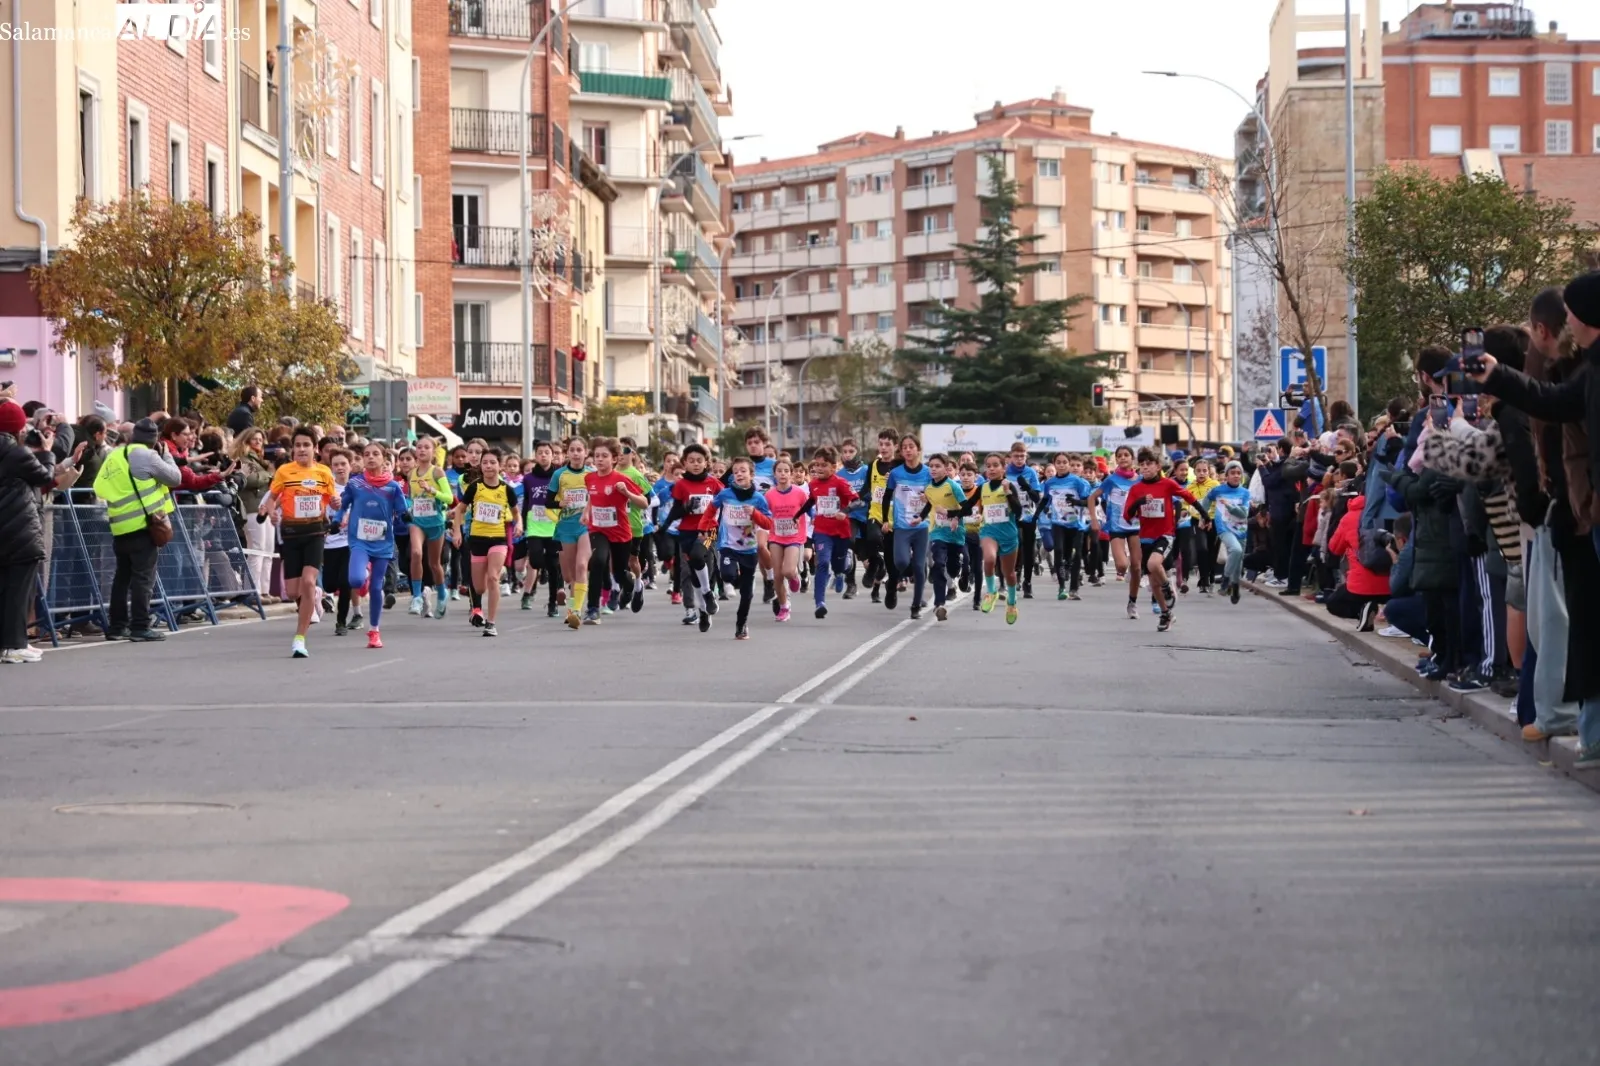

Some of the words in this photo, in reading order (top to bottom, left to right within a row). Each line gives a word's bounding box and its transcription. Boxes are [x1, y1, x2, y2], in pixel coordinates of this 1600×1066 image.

[406, 380, 449, 394] HELADOS
[461, 408, 478, 429] San
[479, 409, 522, 426] ANTONIO
[299, 501, 317, 511] 6531
[478, 506, 496, 517] 6428
[363, 524, 378, 535] 6411
